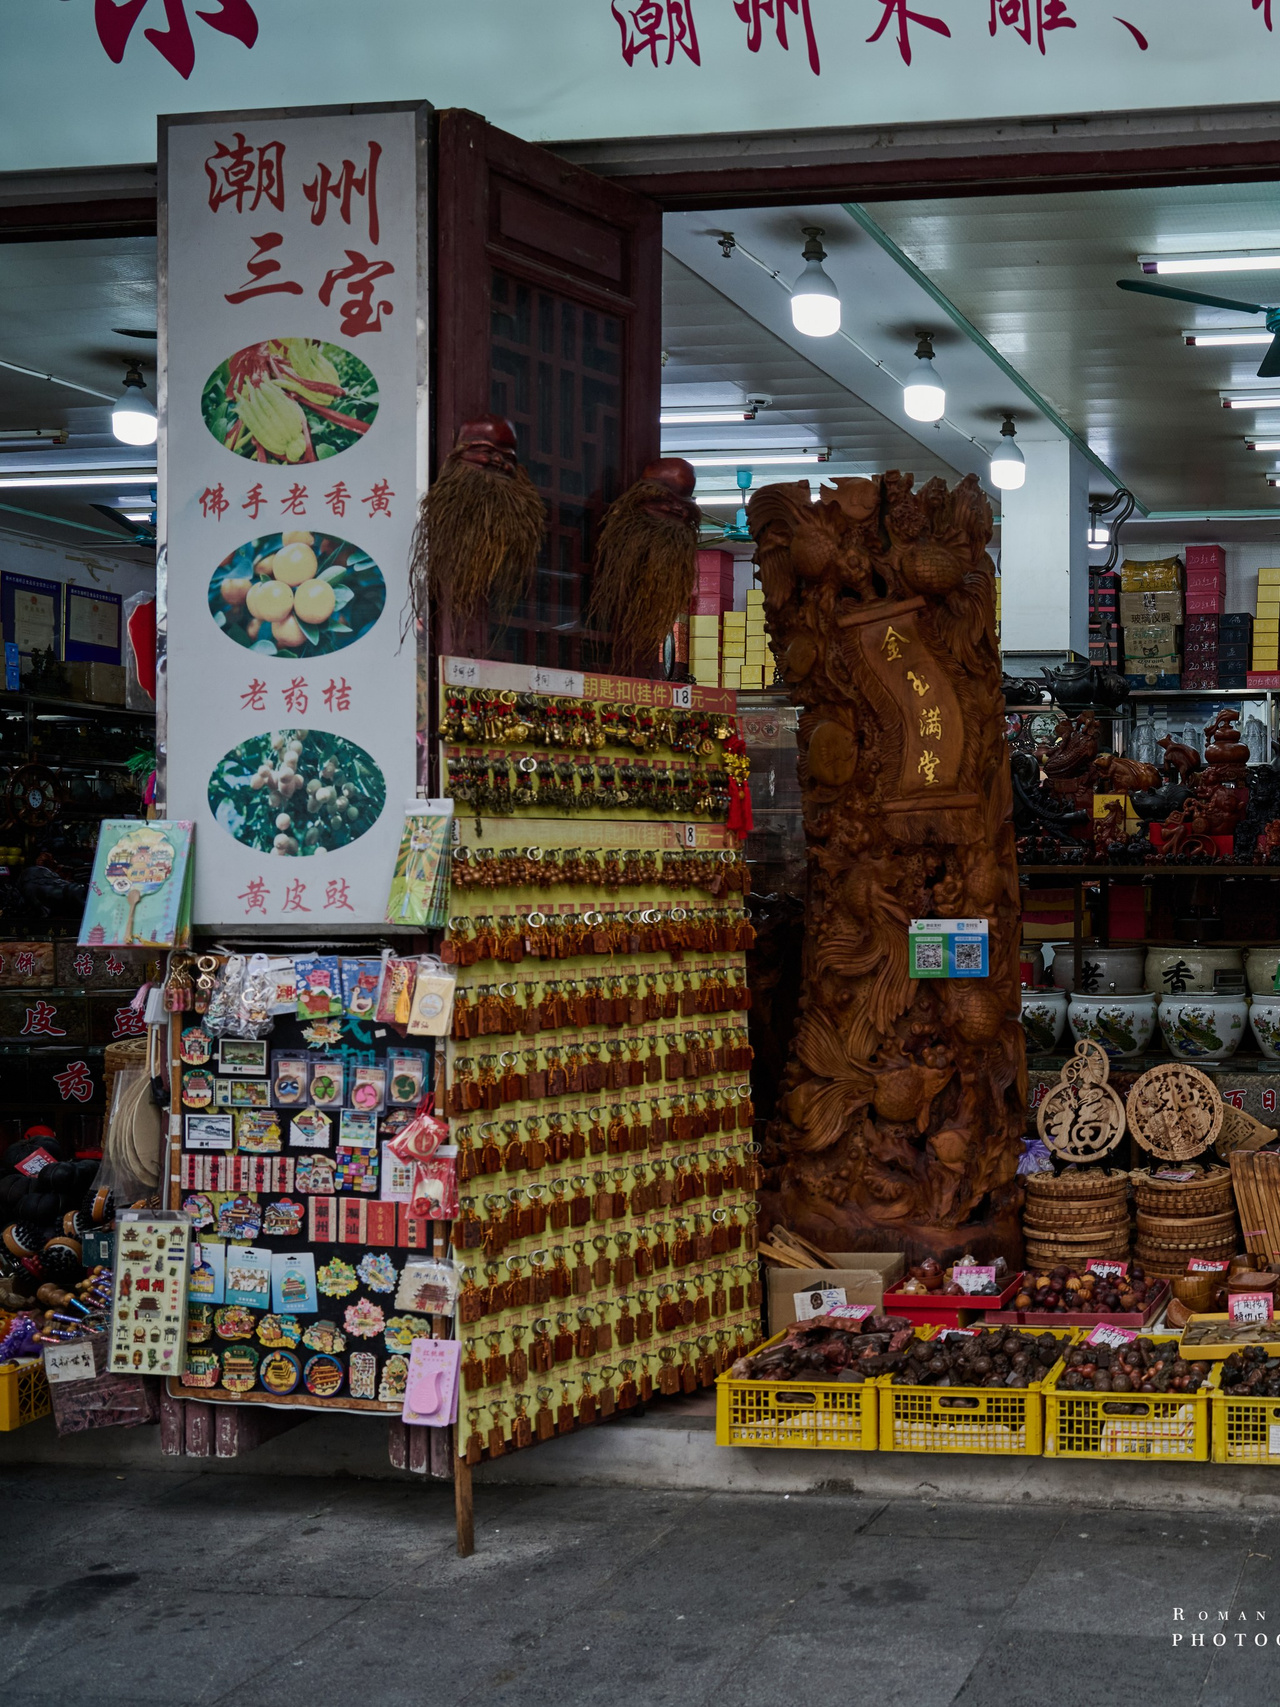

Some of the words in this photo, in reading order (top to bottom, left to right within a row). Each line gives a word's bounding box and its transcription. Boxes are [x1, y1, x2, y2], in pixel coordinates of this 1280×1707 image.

[204, 132, 383, 245] 潮州
[224, 231, 395, 337] 三宝
[199, 478, 396, 522] 佛手老香黄
[1131, 612, 1171, 624] 玻璃仪器
[240, 676, 353, 715] 老药桔
[880, 625, 943, 786] 金玉满堂
[238, 876, 356, 916] 黄皮豉
[73, 953, 125, 976] 话梅
[1162, 961, 1195, 993] 香
[53, 1061, 94, 1102] 药
[315, 1206, 329, 1233] 潮州
[346, 1207, 360, 1235] 潮汕
[135, 1278, 165, 1293] 潮州
[415, 1298, 445, 1313] 潮州
